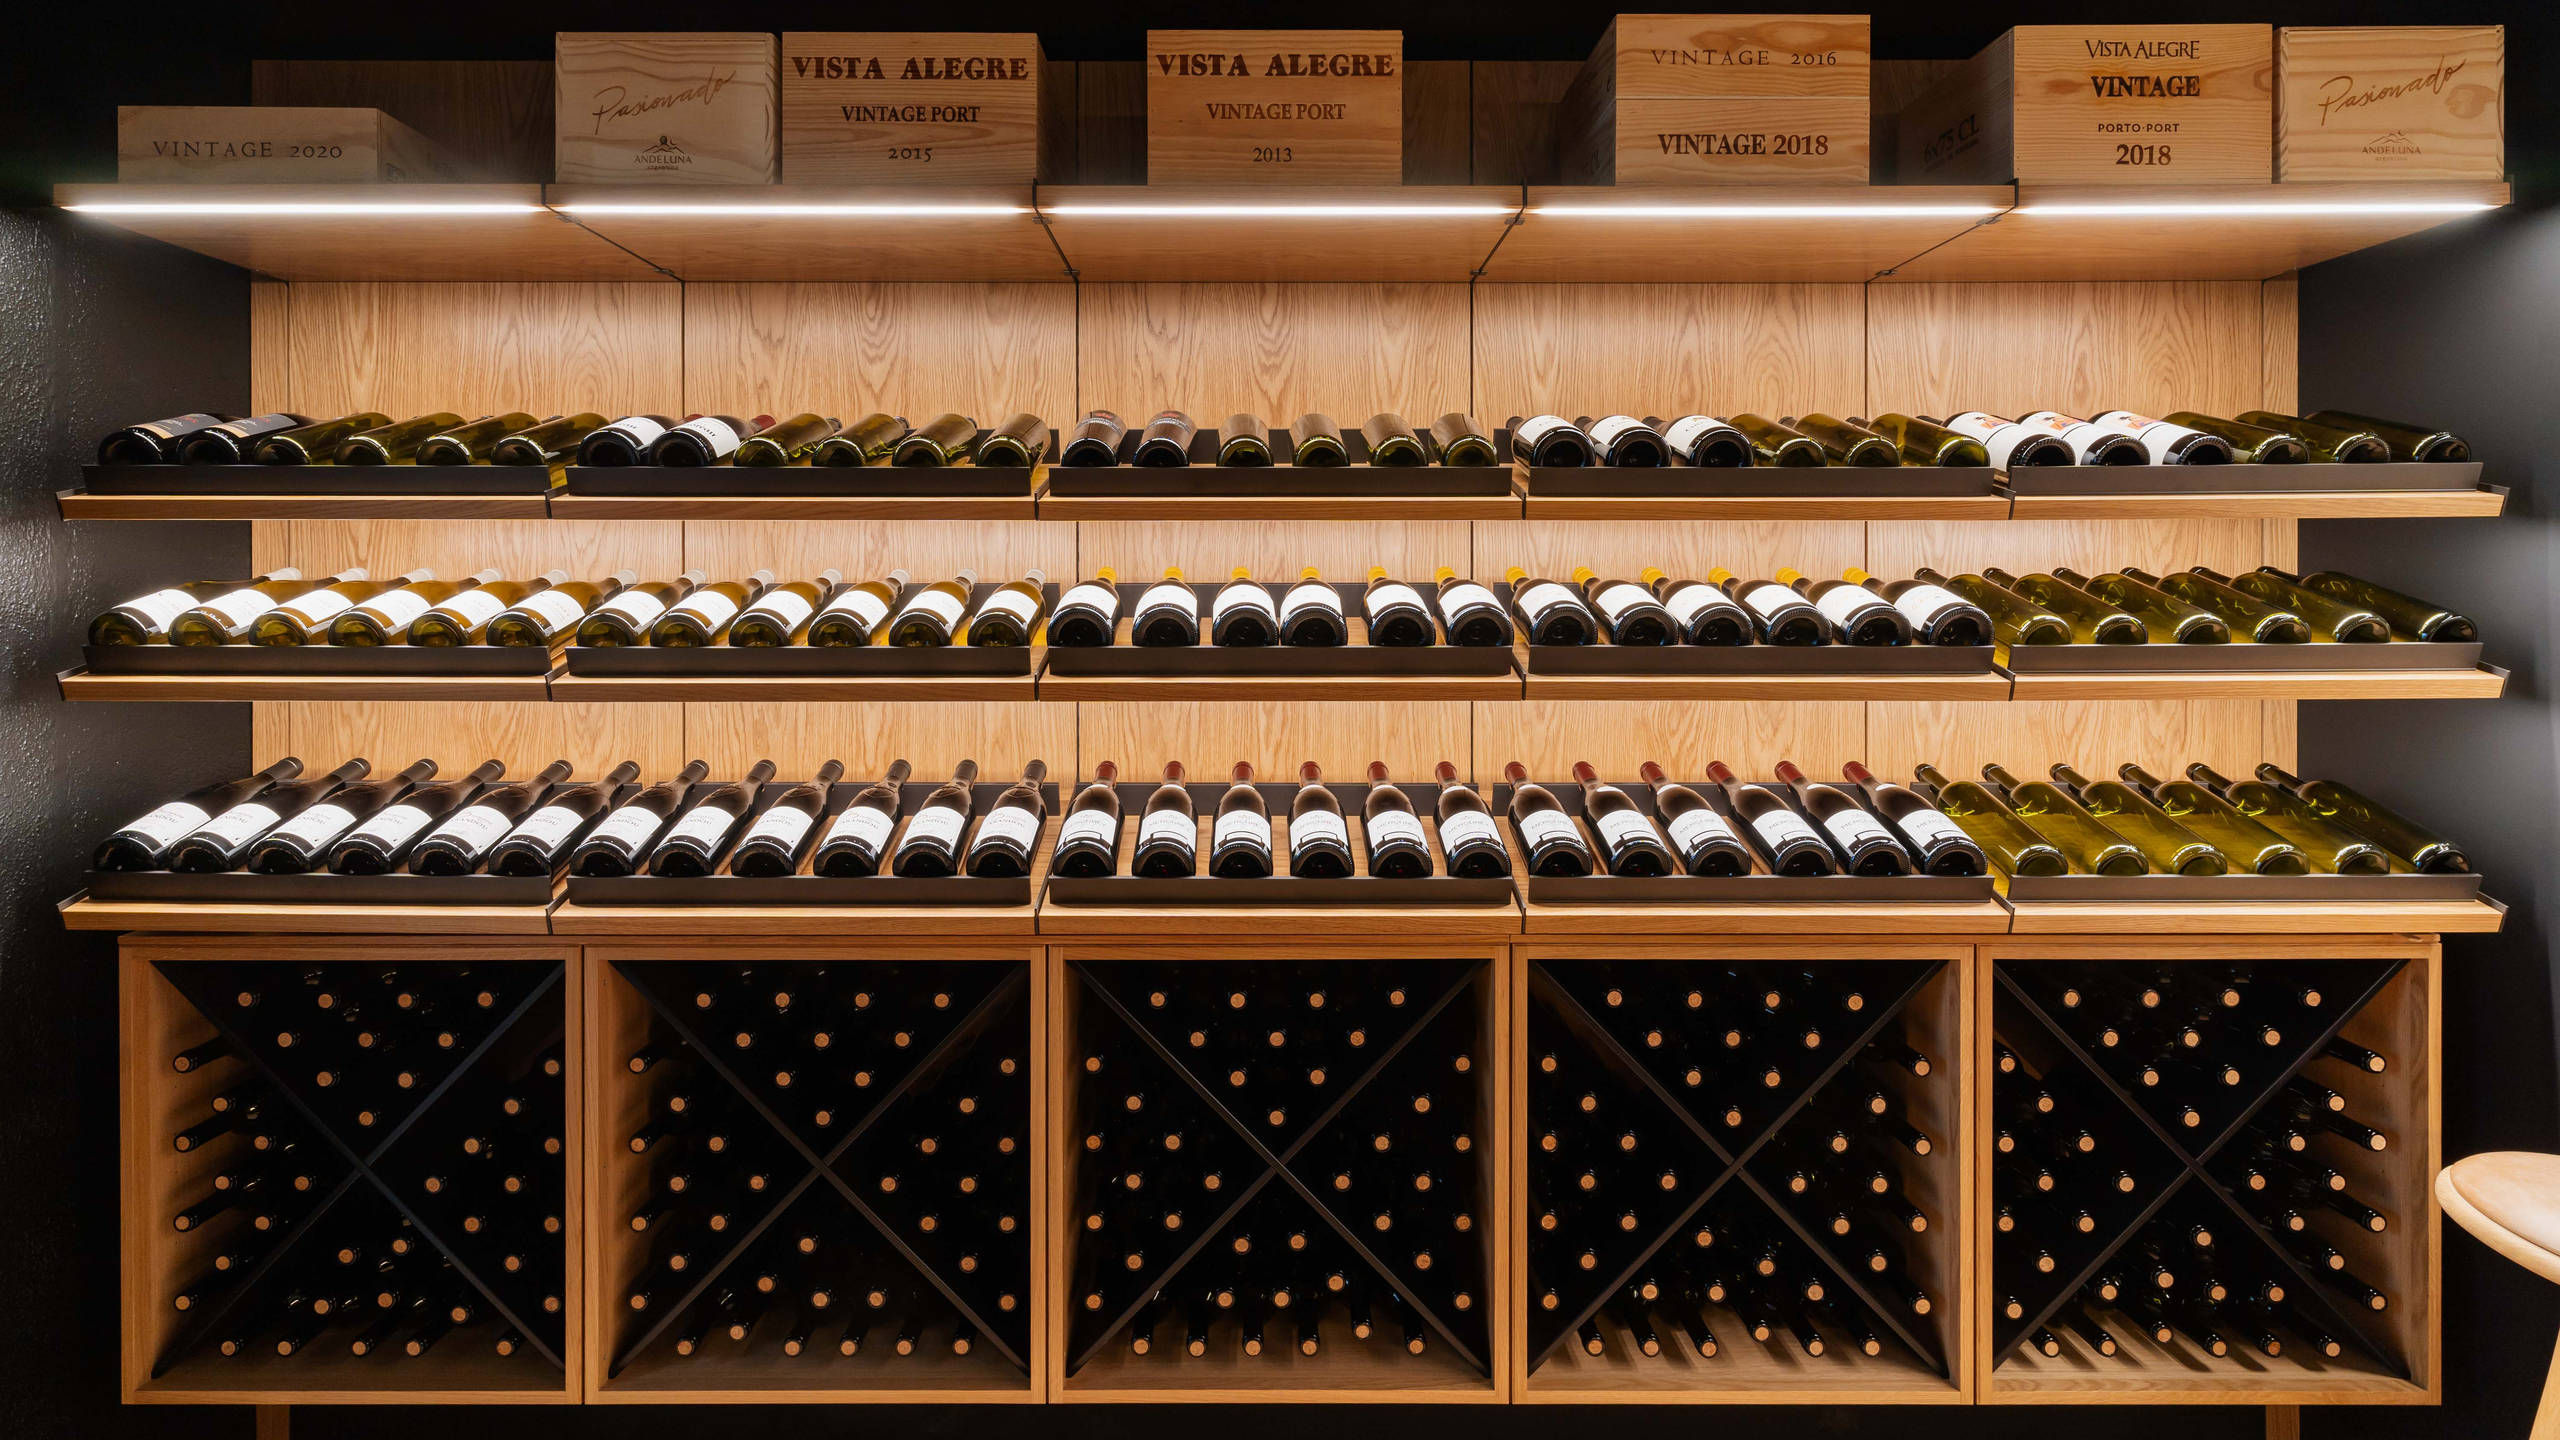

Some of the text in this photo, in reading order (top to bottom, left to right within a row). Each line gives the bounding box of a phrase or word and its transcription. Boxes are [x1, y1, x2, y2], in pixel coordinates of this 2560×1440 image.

[1651, 49, 1837, 66] VINTAGE 2016
[2084, 39, 2200, 60] VISTA ALEGRE
[791, 56, 1030, 81] VISTA ALEGRE
[1156, 53, 1395, 77] VISTA ALEGRE
[2090, 75, 2200, 97] VINTAGE
[2318, 55, 2467, 127] Pasionado
[592, 66, 736, 136] Pasionado
[1206, 103, 1346, 120] VINTAGE PORT
[841, 105, 981, 122] VINTAGE PORT
[152, 141, 343, 159] VINTAGE 2020
[888, 147, 933, 162] 2015
[1252, 147, 1293, 163] 2013
[1657, 134, 1829, 156] VINTAGE 2018
[2115, 143, 2172, 166] 2018
[633, 155, 693, 165] ANDELUNA
